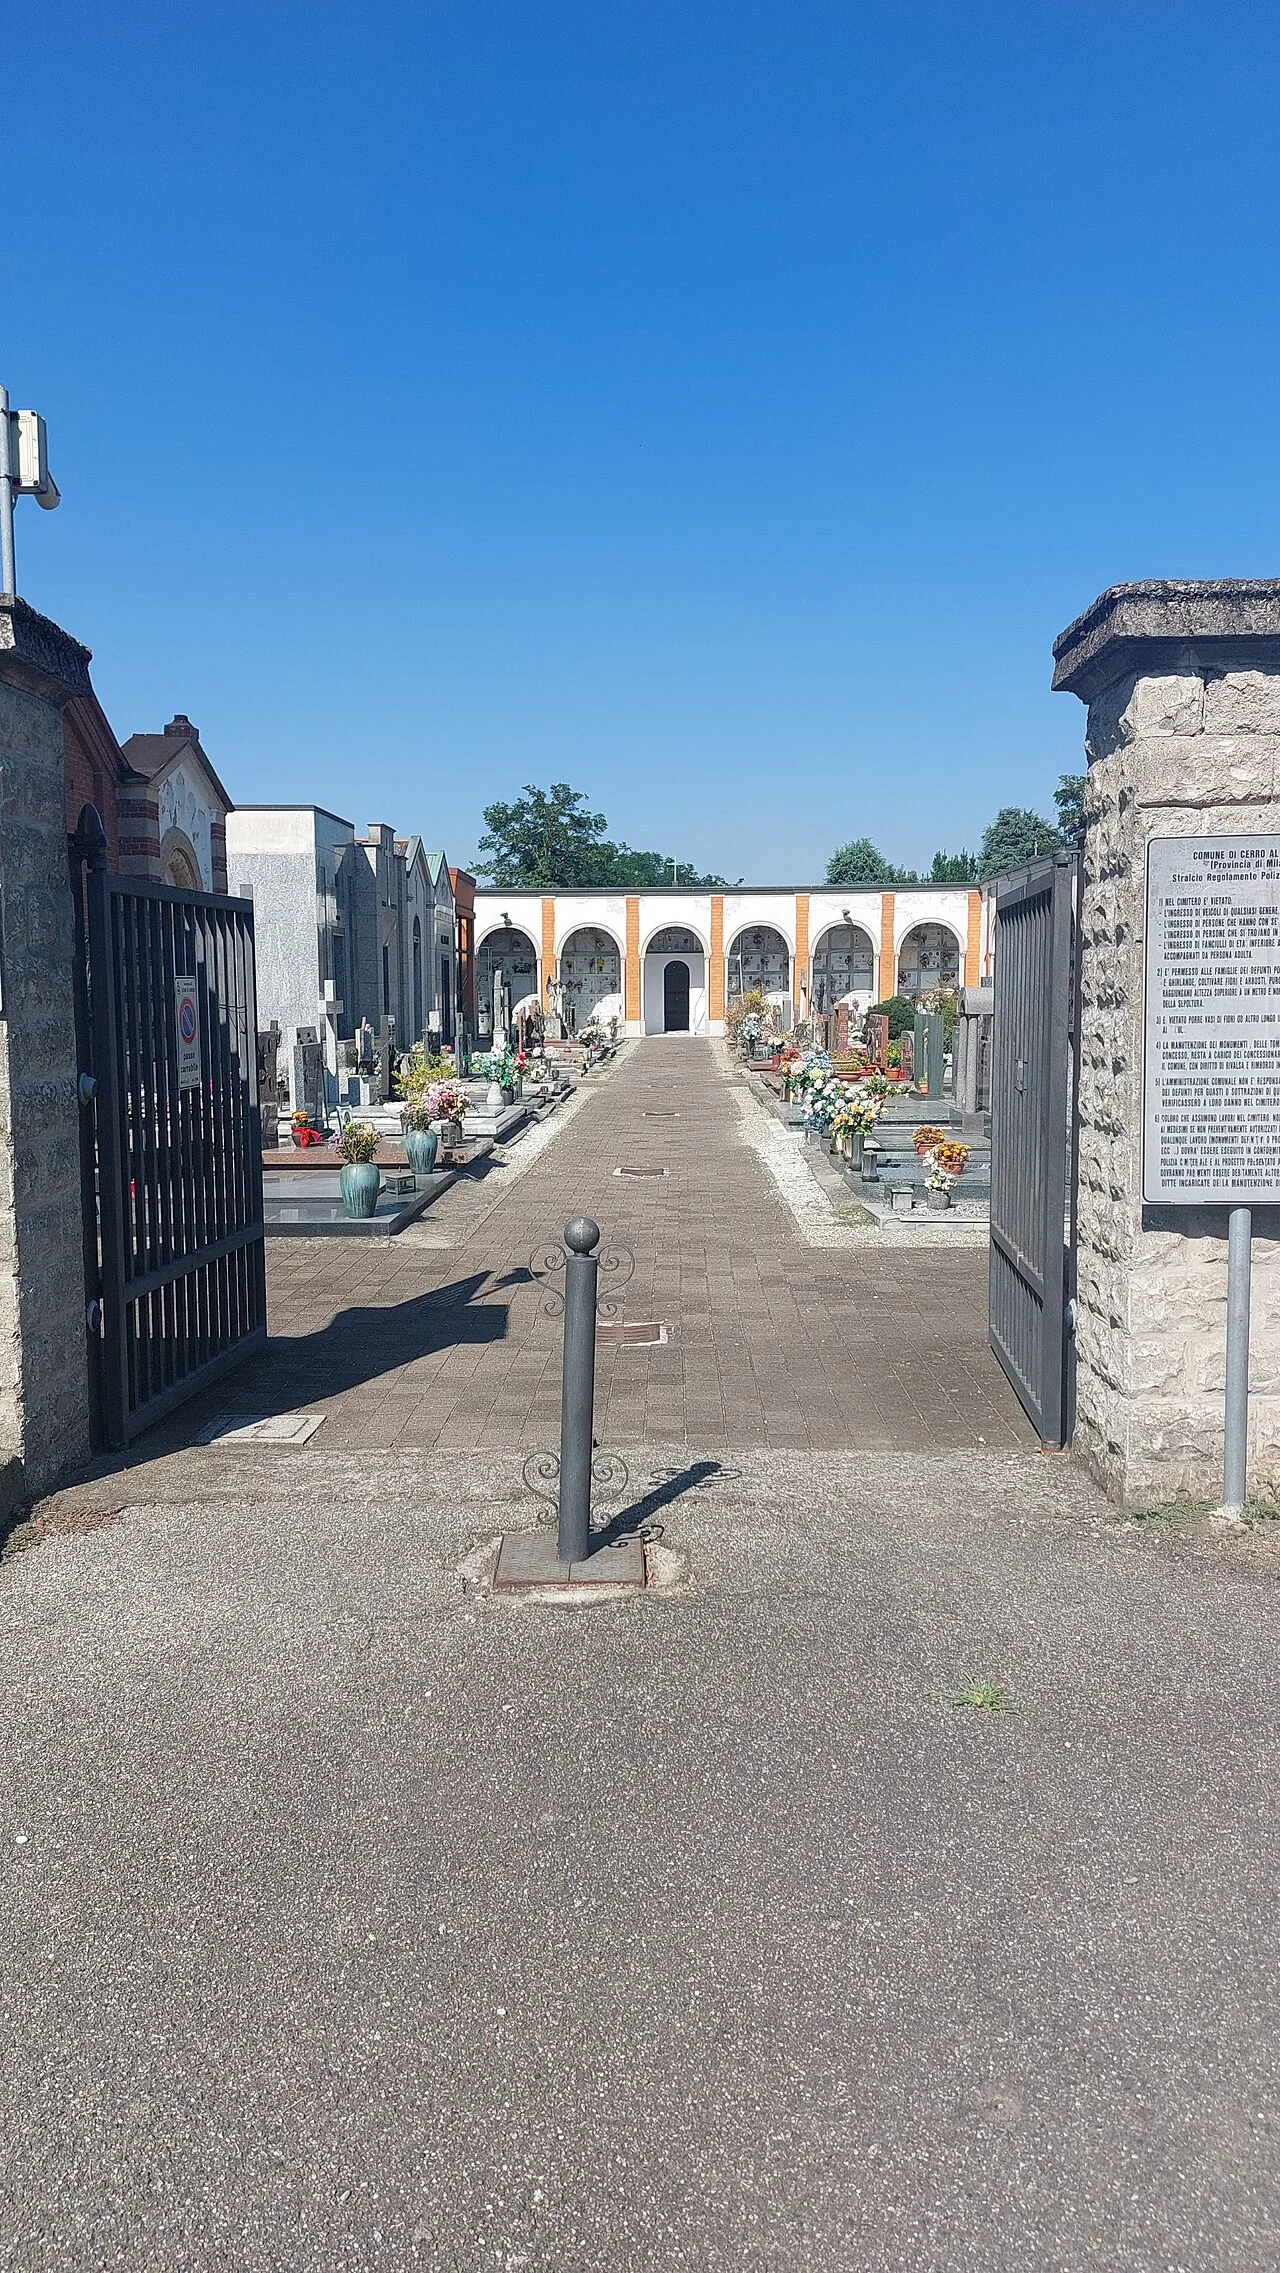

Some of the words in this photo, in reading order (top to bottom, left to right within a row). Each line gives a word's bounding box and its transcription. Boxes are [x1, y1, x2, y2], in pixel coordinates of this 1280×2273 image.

[1194, 851, 1225, 860] COMUNE
[1241, 850, 1265, 858] CERRO
[1269, 849, 1278, 858] AL
[1210, 860, 1250, 870] (Provincia
[1172, 874, 1202, 882] Stralcio
[1207, 872, 1257, 882] Regolamento
[1177, 897, 1201, 906] CIMITERO
[1164, 908, 1193, 917] L'INGRESSO
[1203, 908, 1221, 916] VEICOLI
[1231, 907, 1257, 916] QUALSIASI
[1164, 920, 1192, 928] L'INGRESSO
[1164, 930, 1192, 939] L'INGRESSO
[1164, 941, 1192, 949] L'INGRESSO
[1202, 940, 1226, 948] FANCIULLI
[1164, 952, 1200, 960] ACCOMPAGNATI
[1172, 968, 1198, 976] PERMESSO
[1215, 967, 1237, 975] FAMIGLIE
[1169, 1016, 1186, 1024] VIETATO
[1214, 1051, 1232, 1059] CARICO
[1162, 1078, 1209, 1086] L'AMMINISTRAZIONE
[1212, 1078, 1236, 1086] COMUNALE
[1208, 1125, 1247, 1133] PREVENTVAMENTE
[1161, 1136, 1187, 1145] QUALUNQUE
[1187, 1169, 1211, 1177] PARMENTI
[1232, 1179, 1272, 1187] MANUTENZIONE
